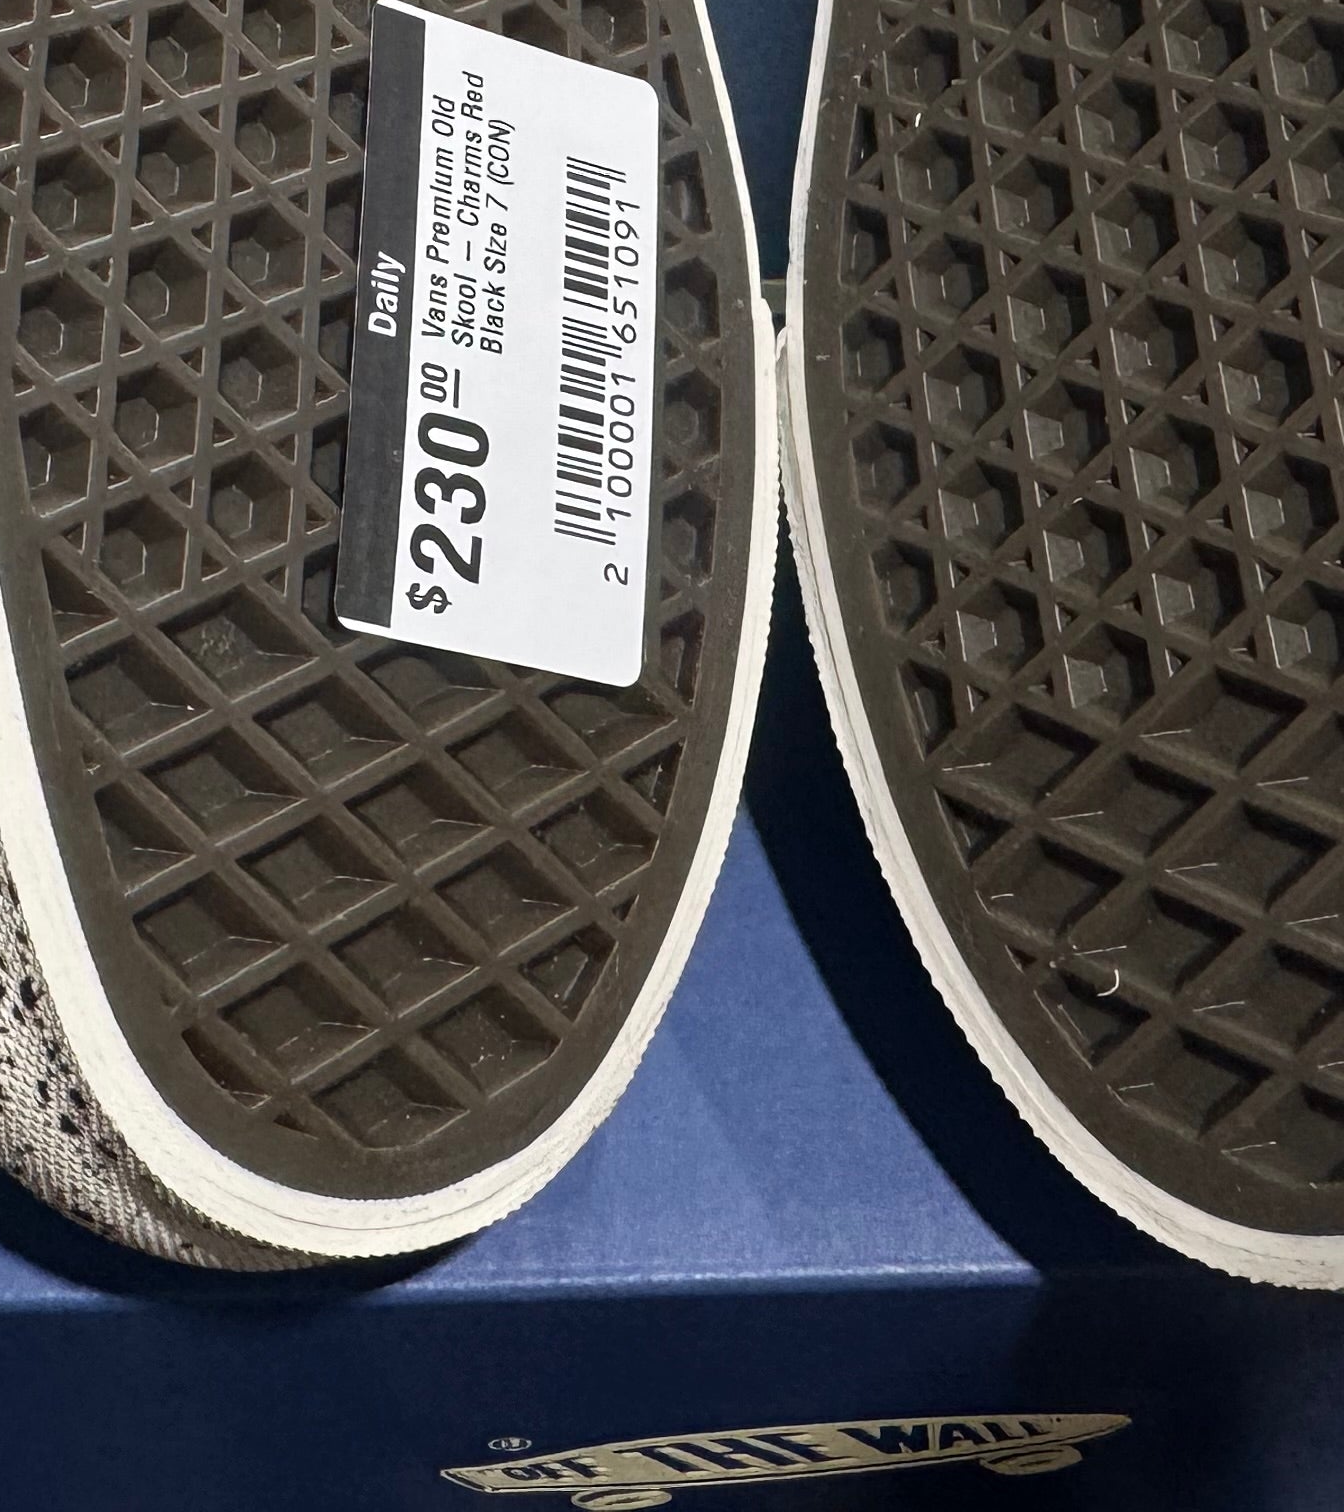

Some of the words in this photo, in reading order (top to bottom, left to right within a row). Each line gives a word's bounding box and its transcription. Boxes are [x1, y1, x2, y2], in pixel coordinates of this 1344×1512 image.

[431, 94, 454, 137] Old
[460, 70, 483, 121] Red
[456, 129, 482, 226] Charms
[486, 119, 515, 185] (CON)
[425, 146, 453, 264] Premium
[485, 192, 508, 211] 7
[483, 222, 506, 274] Size
[611, 199, 640, 343] 651091
[367, 251, 405, 336] Daily
[421, 273, 447, 337] Vans
[451, 273, 476, 347] Skool
[479, 281, 505, 354] Black
[606, 372, 635, 521] 100001
[603, 562, 628, 585] 2
[613, 1430, 854, 1475] THE
[837, 1421, 1052, 1455] WALL
